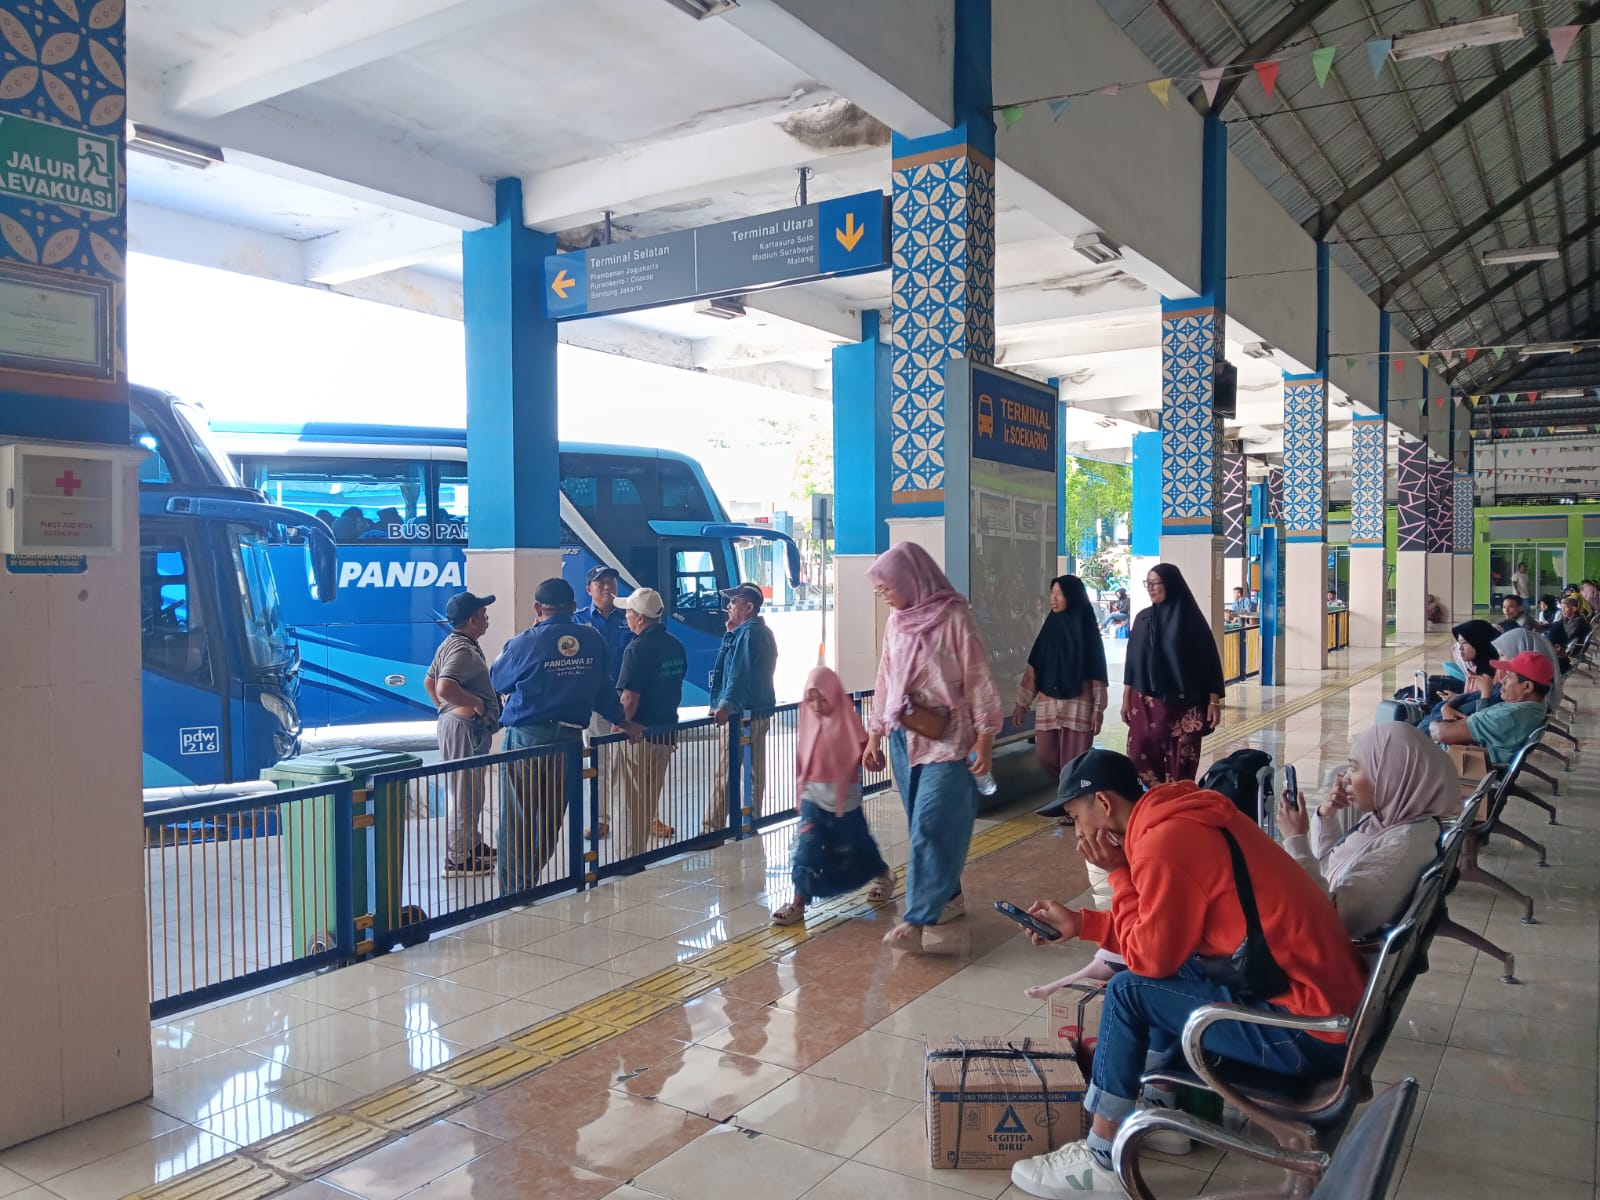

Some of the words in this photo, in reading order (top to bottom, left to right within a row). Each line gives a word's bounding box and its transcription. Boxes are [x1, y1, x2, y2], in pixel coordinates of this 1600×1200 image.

[6, 150, 76, 181] JALUR
[7, 172, 112, 209] EVAKUASI
[731, 222, 779, 242] Terminal
[783, 218, 814, 232] Utara
[759, 238, 795, 250] Kartasura
[797, 234, 814, 244] Solo
[590, 251, 631, 268] Terminal
[633, 246, 670, 260] Selatan
[779, 245, 814, 257] Surabaya
[787, 255, 814, 265] Malang
[590, 270, 625, 281] Prambanan
[590, 279, 625, 290] Purwokerto
[630, 274, 654, 284] Cilacap
[590, 289, 618, 299] Bandung
[619, 285, 643, 295] Jakarta
[1001, 398, 1052, 431] TERMINAL
[388, 523, 431, 539] BUS
[338, 561, 468, 588] PANDA
[544, 658, 585, 669] PANDAWA
[183, 730, 215, 747] pdw
[188, 742, 216, 752] 216
[987, 1134, 1034, 1143] SEGITIGA
[998, 1143, 1024, 1151] BIRU
